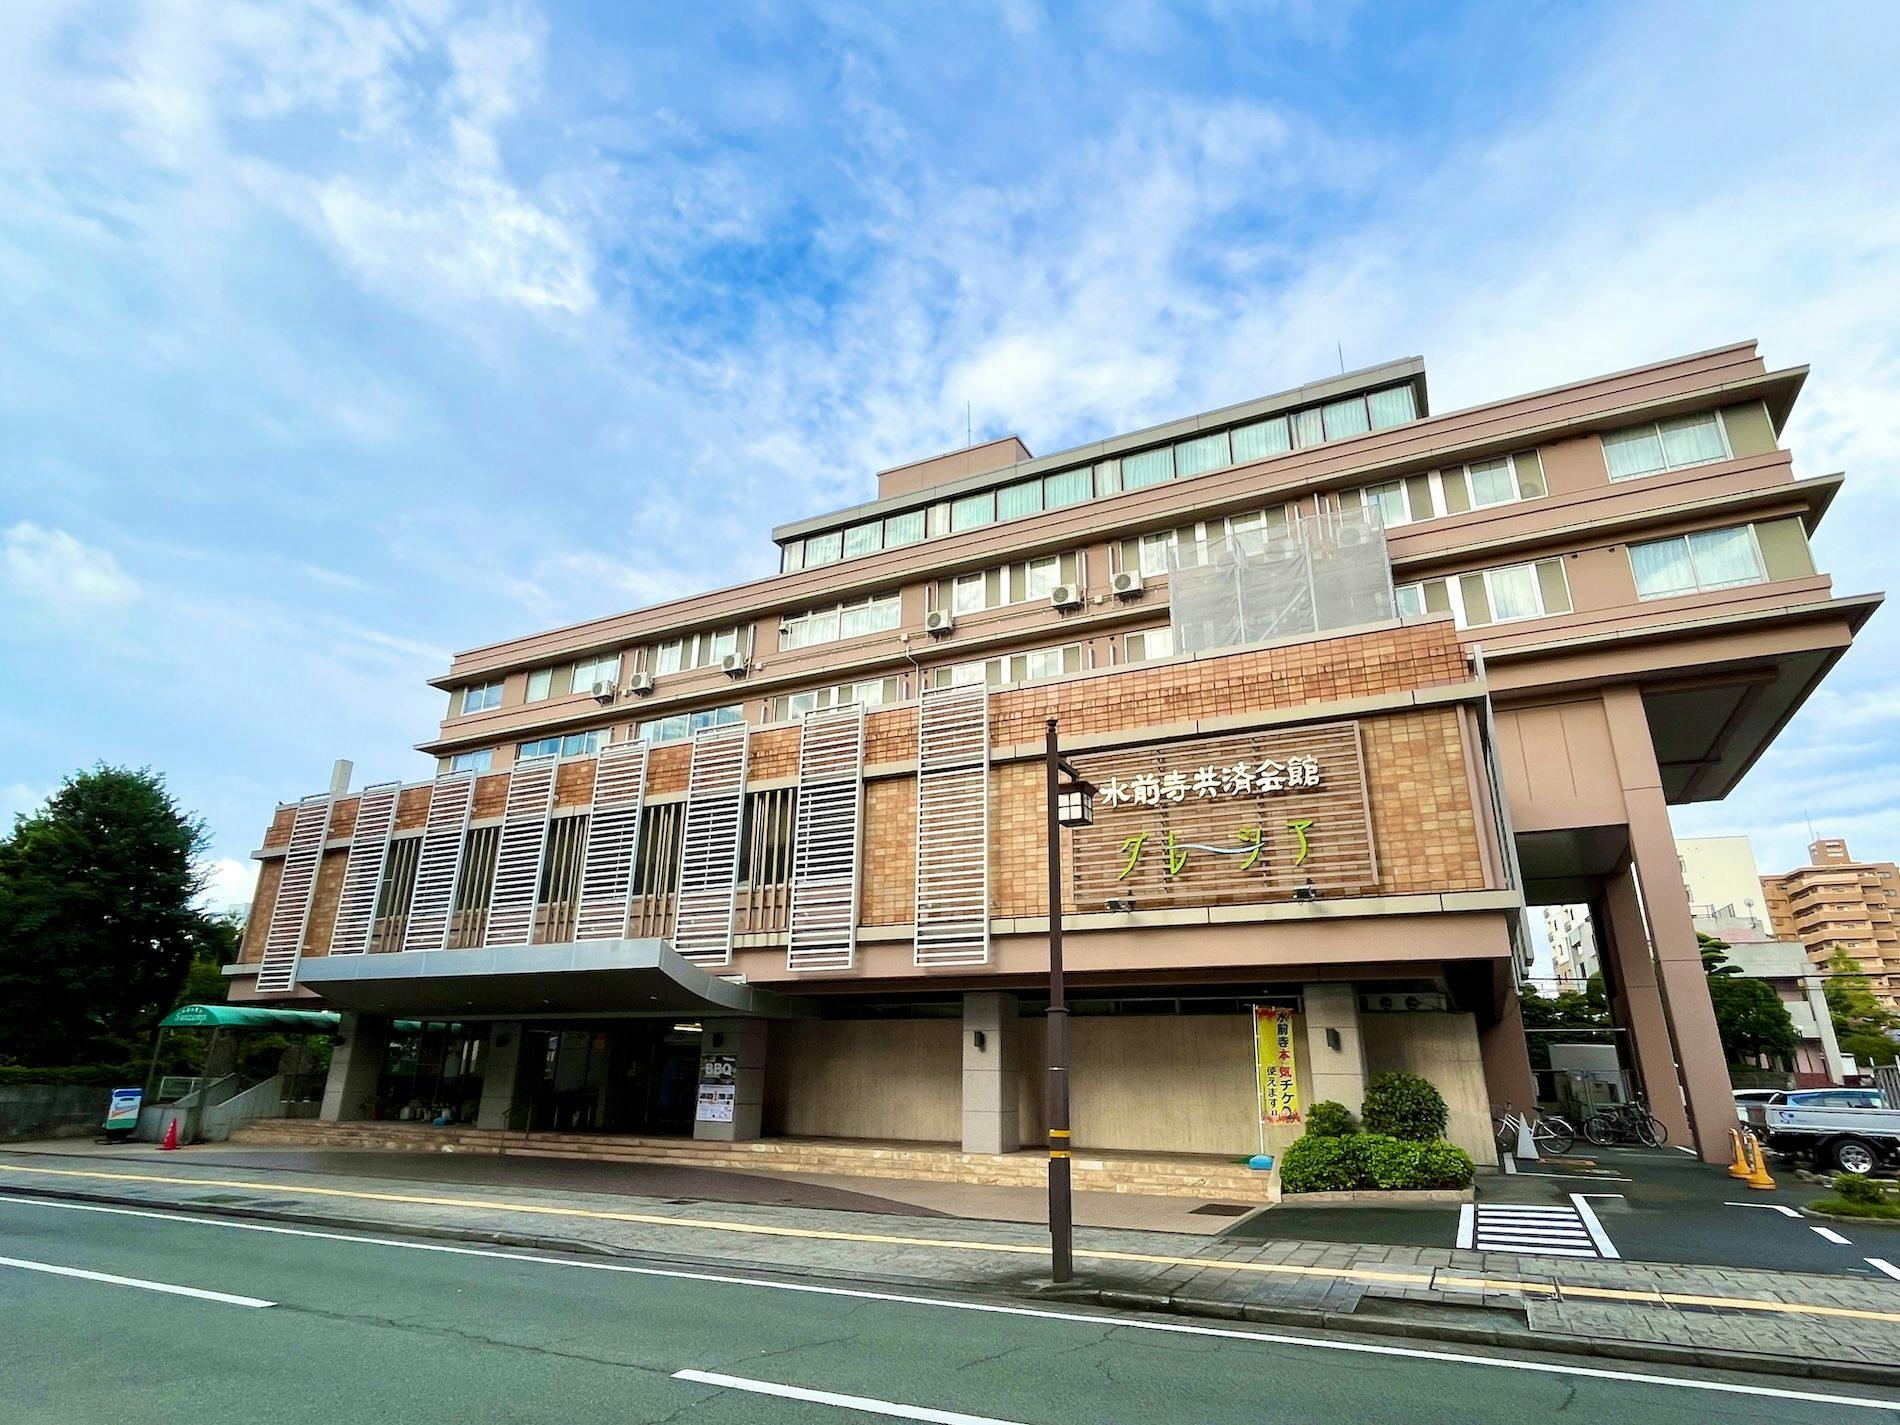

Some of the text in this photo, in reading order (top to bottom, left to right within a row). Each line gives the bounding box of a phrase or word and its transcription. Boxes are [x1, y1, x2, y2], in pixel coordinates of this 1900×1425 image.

[1099, 754, 1321, 808] 水前寺共済会館
[705, 1062, 732, 1076] BBQ
